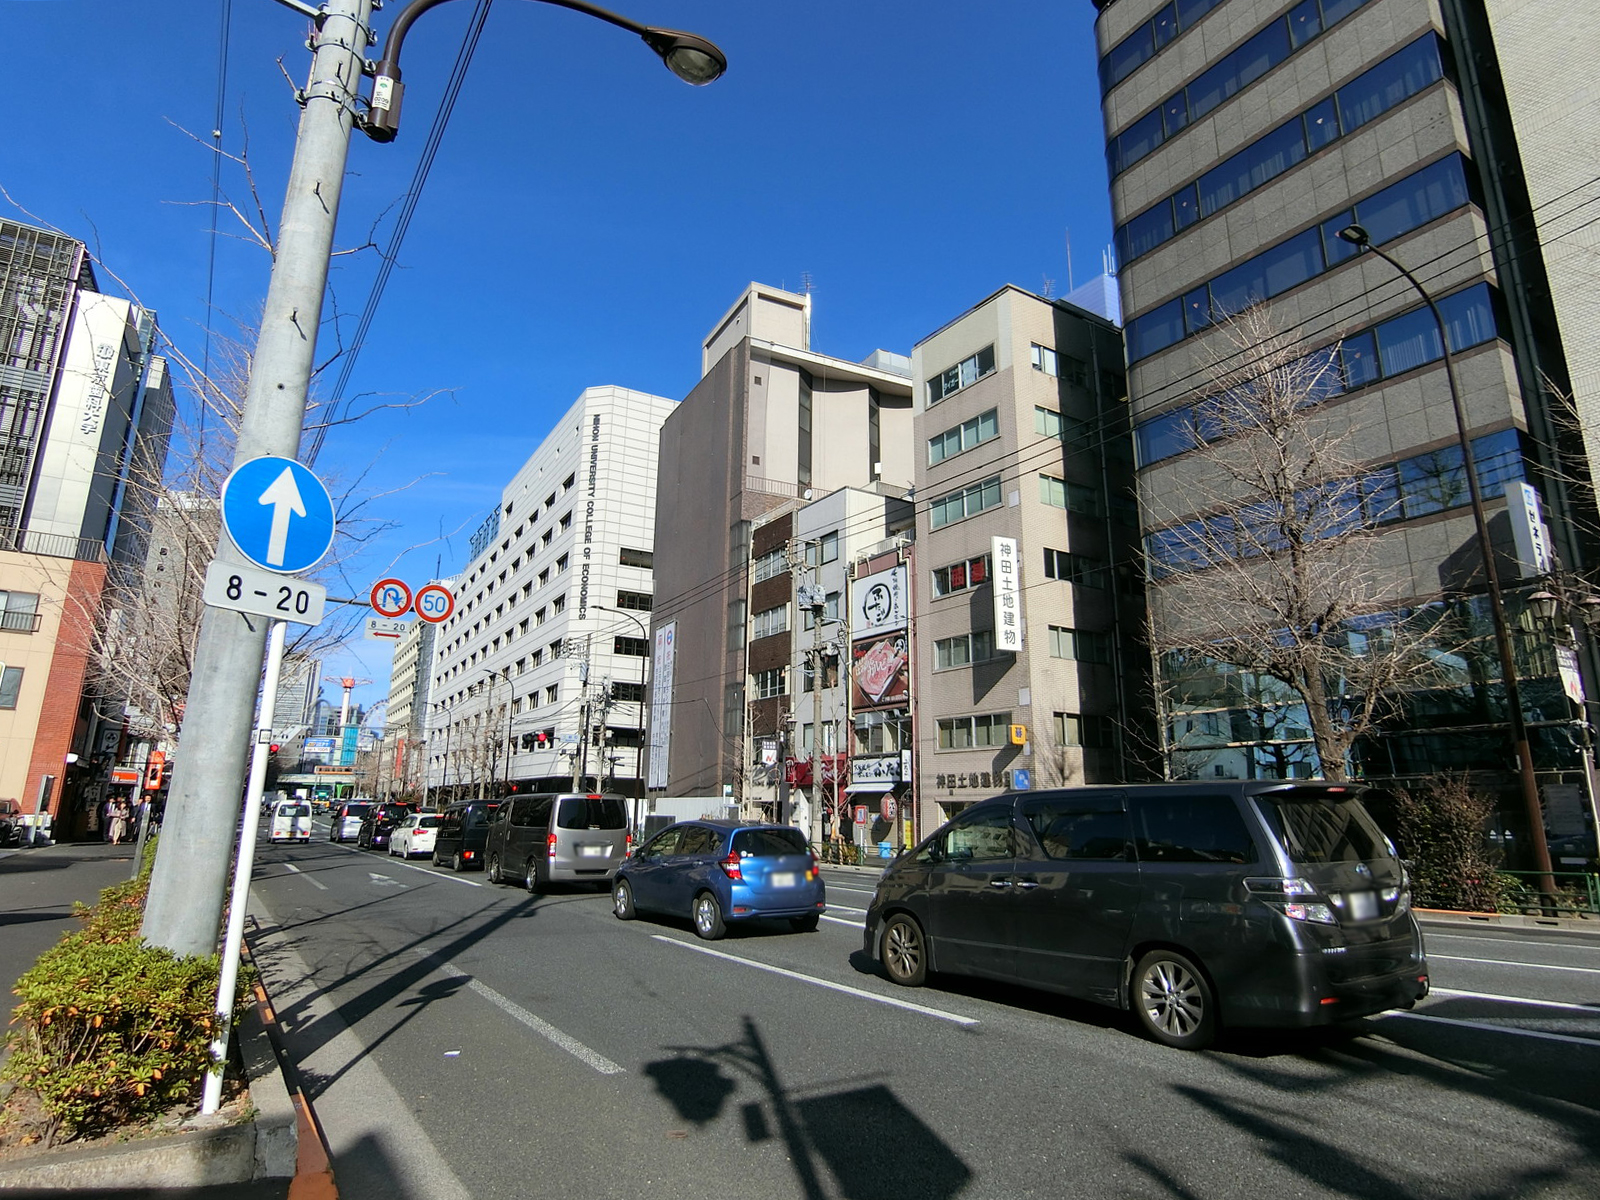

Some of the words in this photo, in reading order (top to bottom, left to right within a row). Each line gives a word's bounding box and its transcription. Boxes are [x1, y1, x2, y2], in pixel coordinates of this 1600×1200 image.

[80, 360, 110, 435] 東京歯科大学
[593, 414, 601, 441] NIHON
[588, 445, 599, 498] UNIVERSITY
[585, 501, 595, 544] COLLEGE
[583, 546, 591, 561] OF
[423, 594, 446, 613] 50
[578, 563, 590, 620] ECONOMICS
[1000, 542, 1016, 645] 神田土地建物
